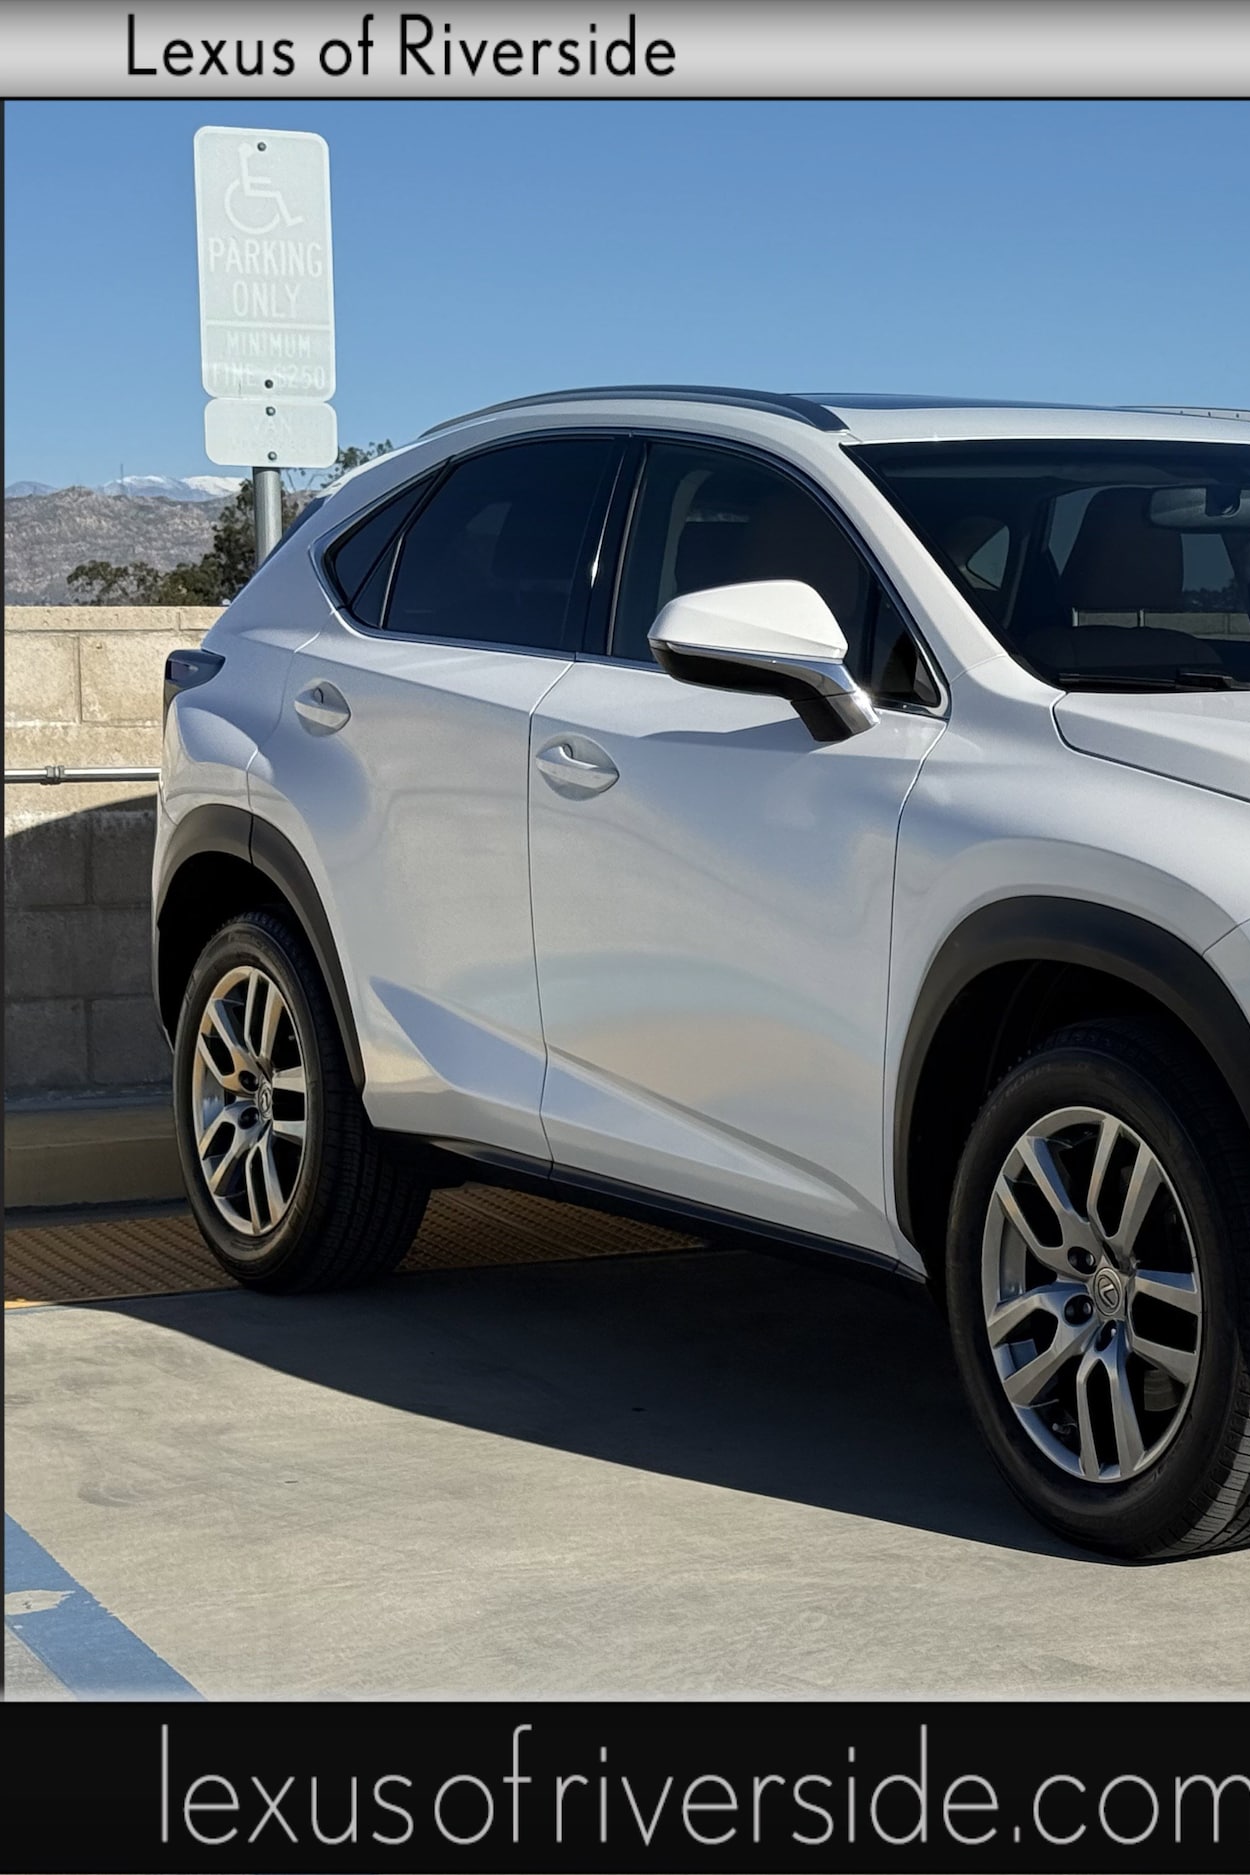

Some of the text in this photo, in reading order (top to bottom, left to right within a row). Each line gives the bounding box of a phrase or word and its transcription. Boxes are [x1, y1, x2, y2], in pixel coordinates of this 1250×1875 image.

[208, 236, 323, 278] PARKING
[232, 280, 301, 319] ONLY
[227, 330, 311, 358] MINIMUM
